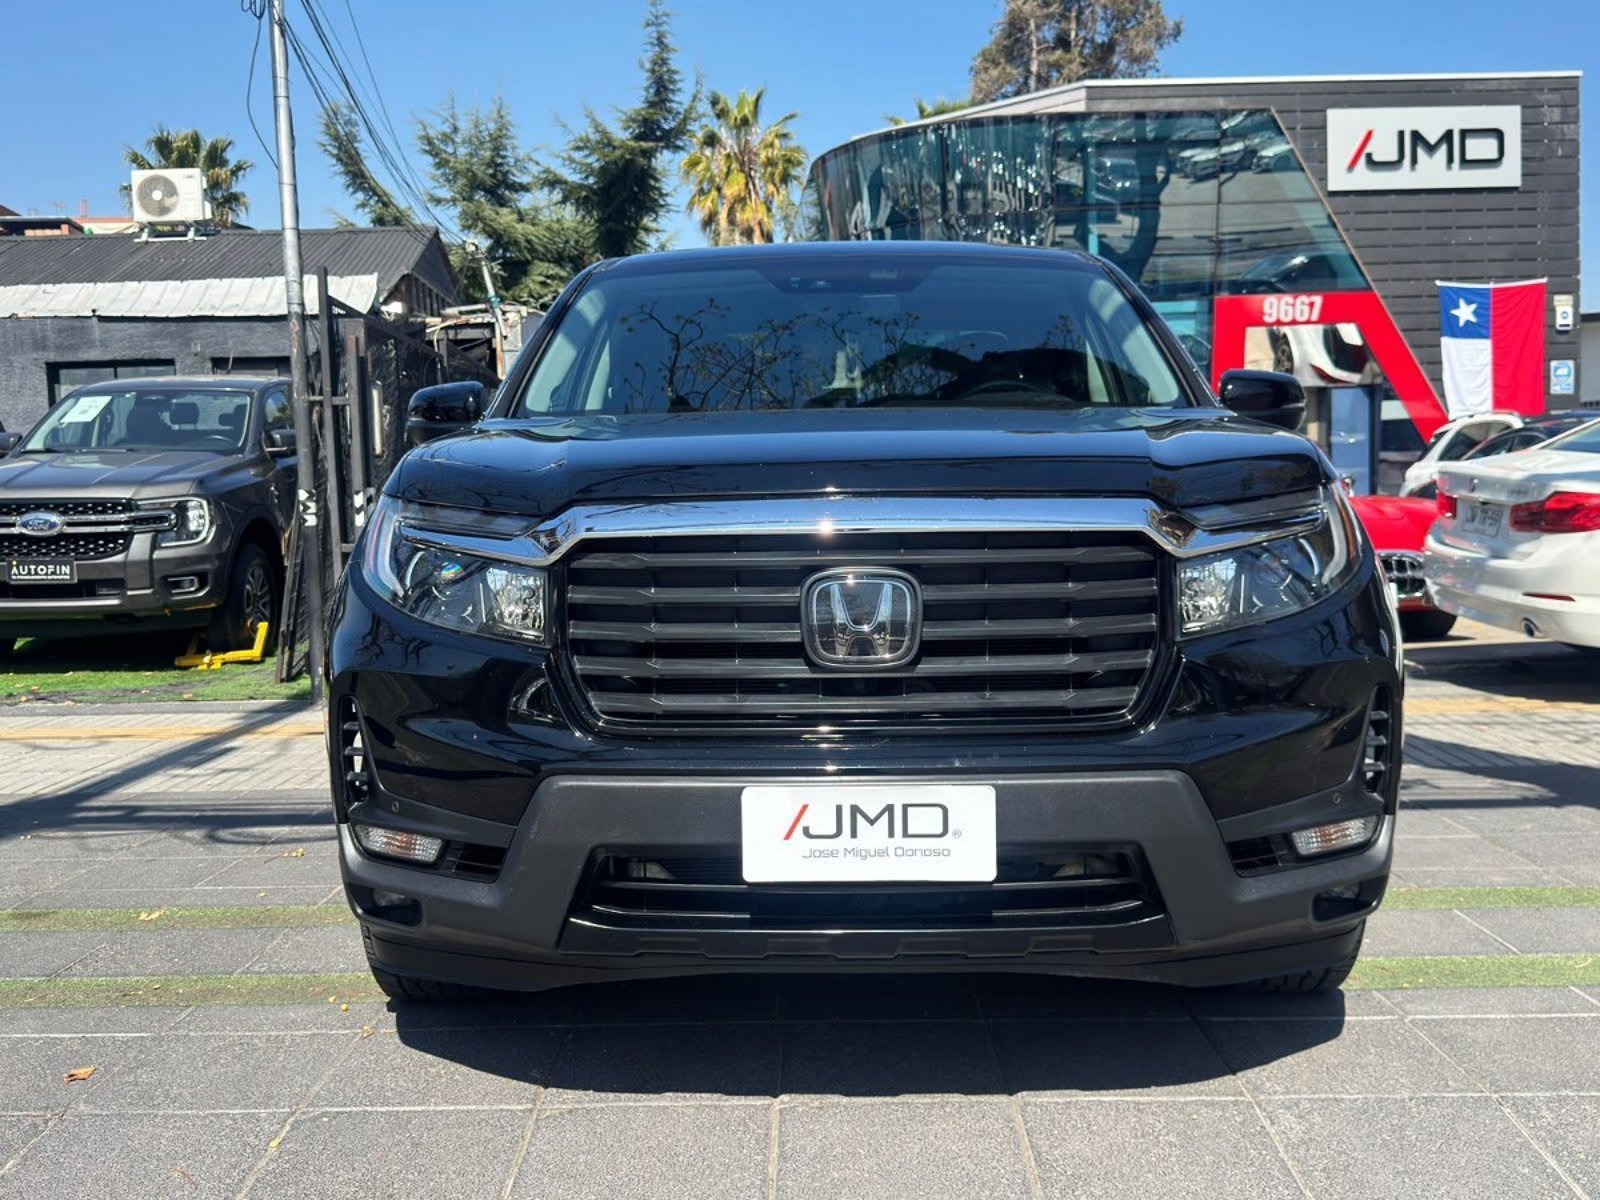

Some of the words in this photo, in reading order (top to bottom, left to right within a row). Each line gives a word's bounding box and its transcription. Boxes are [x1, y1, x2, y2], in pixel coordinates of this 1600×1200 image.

[1263, 295, 1323, 323] 9667
[11, 561, 70, 575] AUTOFIN
[802, 847, 839, 859] Jose
[843, 846, 890, 860] Miguel
[894, 846, 951, 858] Donoso
